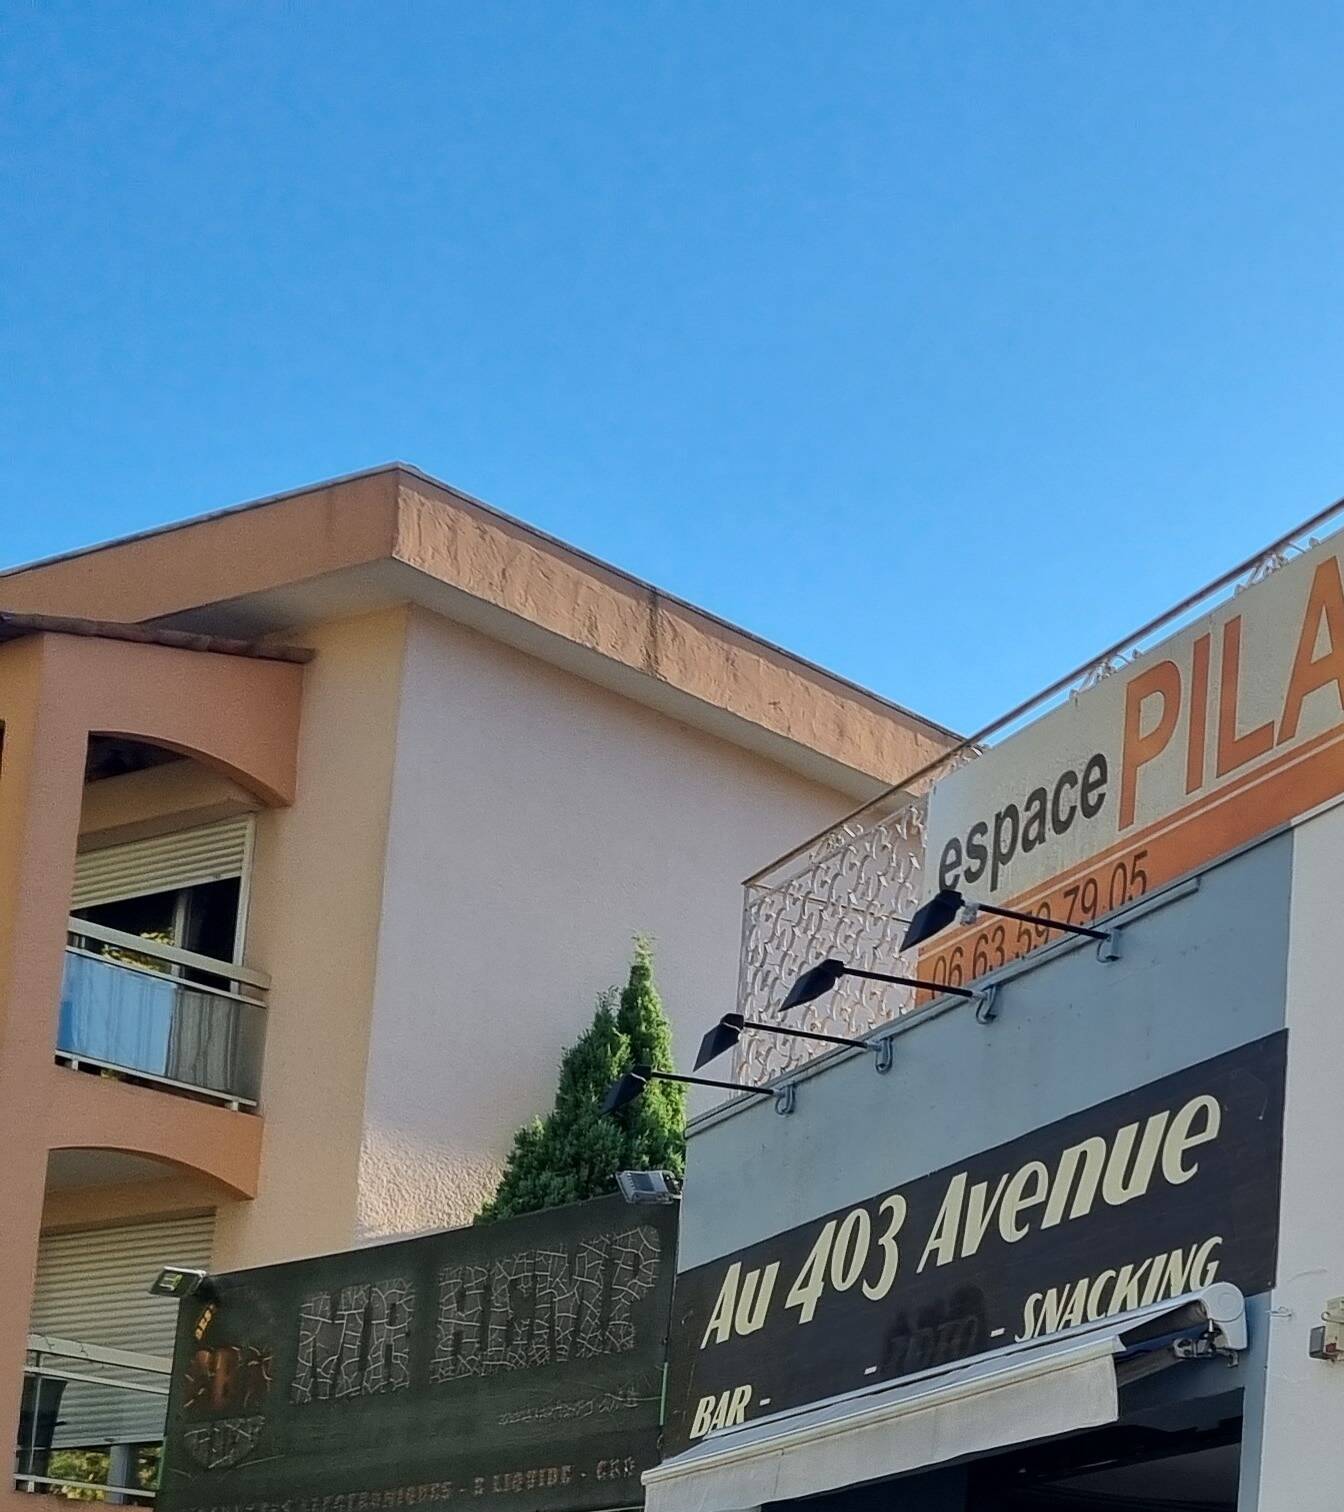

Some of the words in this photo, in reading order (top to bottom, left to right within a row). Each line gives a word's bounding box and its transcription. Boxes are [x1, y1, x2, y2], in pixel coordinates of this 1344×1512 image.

[939, 753, 1108, 892] espace
[701, 1261, 780, 1349] Au
[783, 1194, 907, 1325] 403
[916, 1094, 1221, 1275] Avenue
[690, 1384, 752, 1439] BAR
[1015, 1236, 1222, 1343] SNACKING
